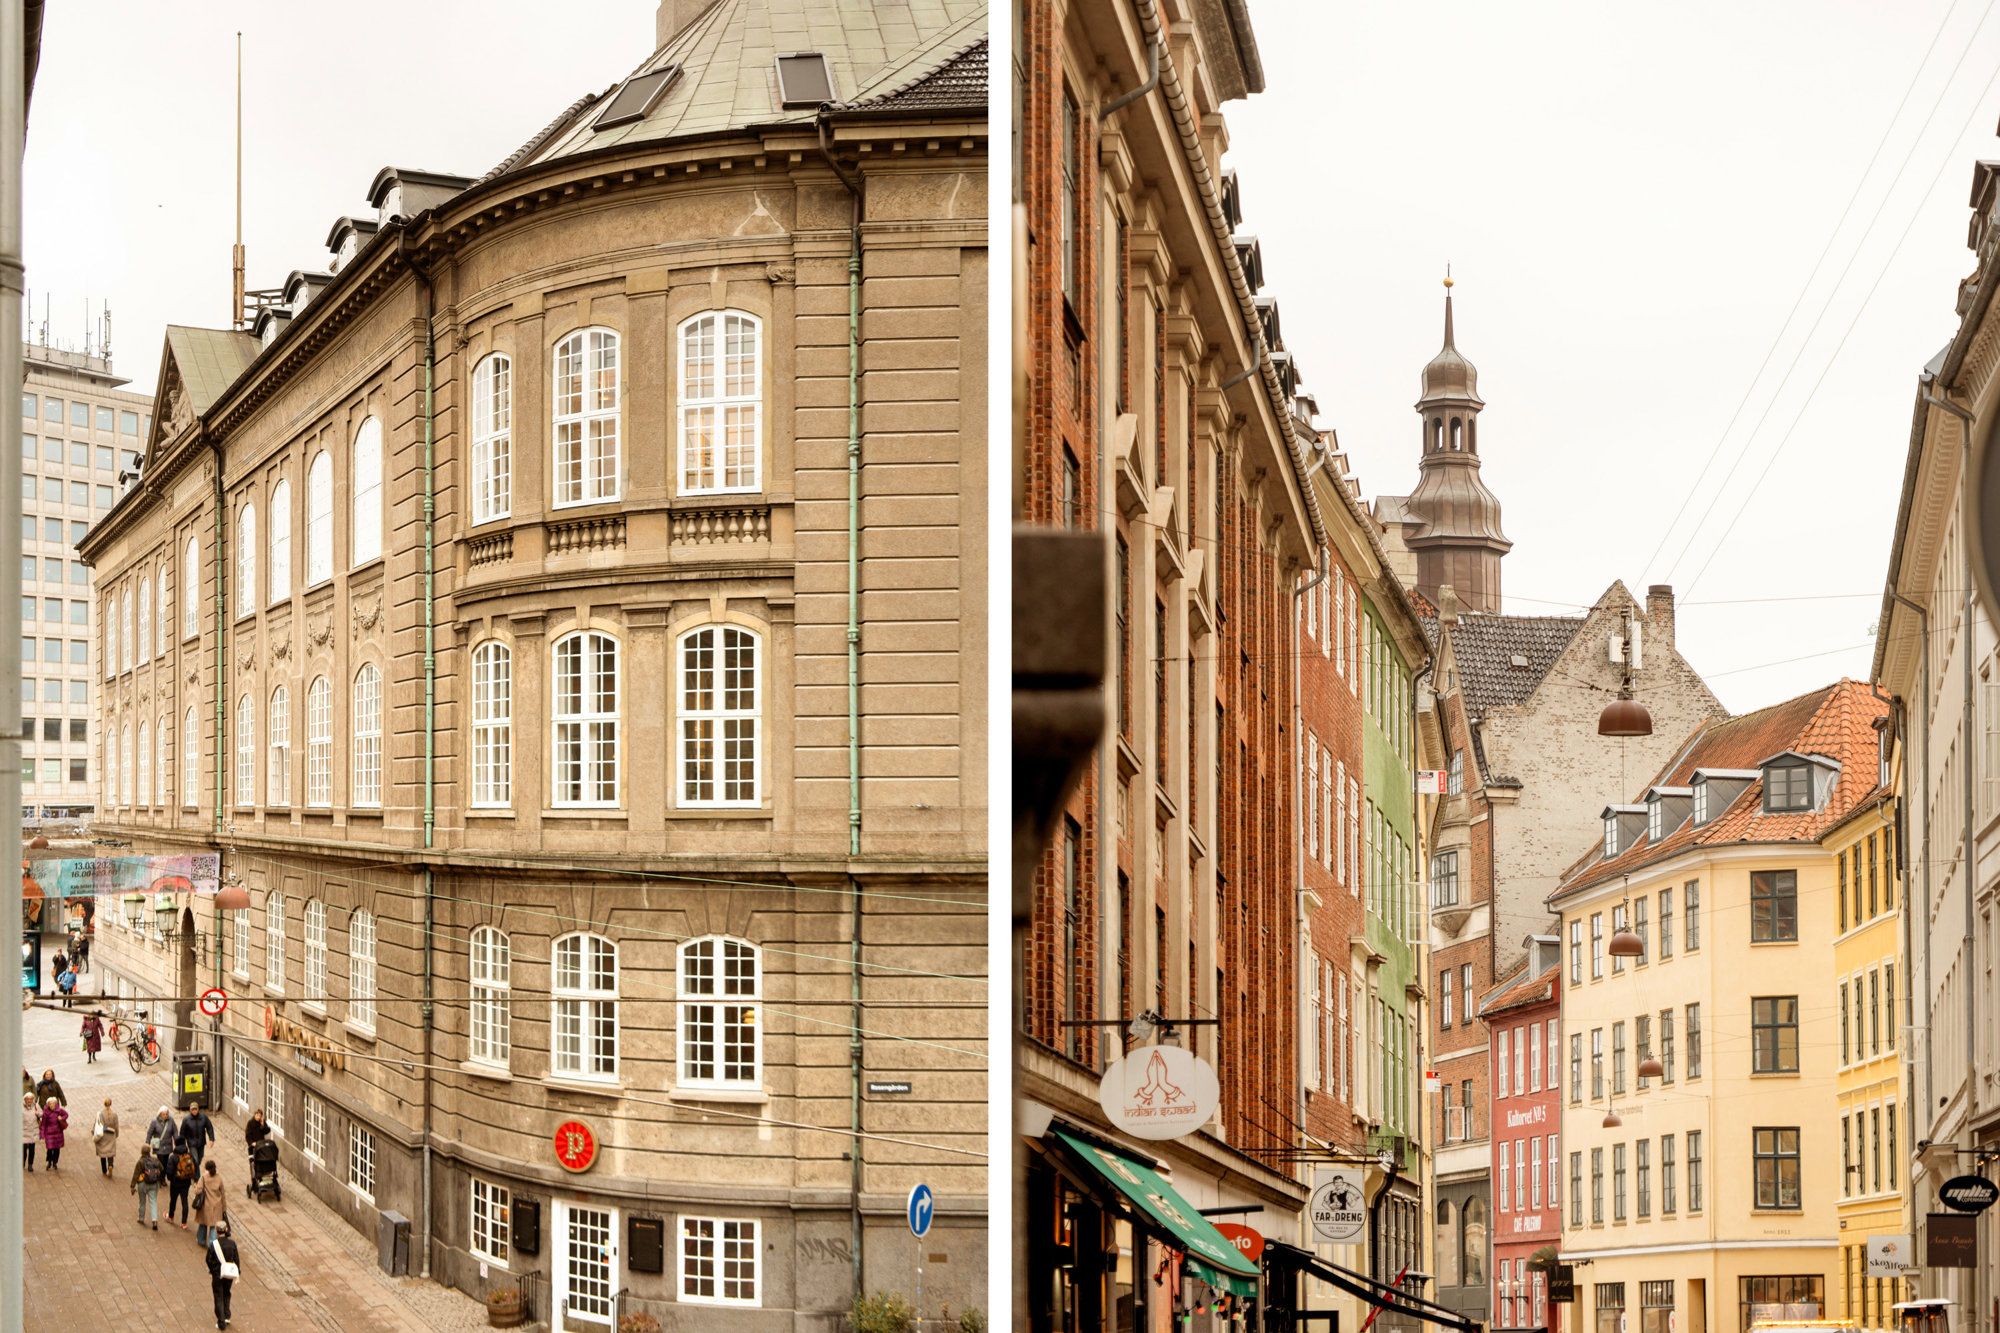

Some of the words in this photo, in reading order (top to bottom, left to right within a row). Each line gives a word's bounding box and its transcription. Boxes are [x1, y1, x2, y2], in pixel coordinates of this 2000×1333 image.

[1123, 1104, 1157, 1118] indian
[1160, 1100, 1197, 1117] swaad
[1507, 1109, 1532, 1127] Kultorvet
[1541, 1105, 1547, 1122] 5
[1335, 1212, 1363, 1222] DRENG
[1228, 1235, 1252, 1250] nfo
